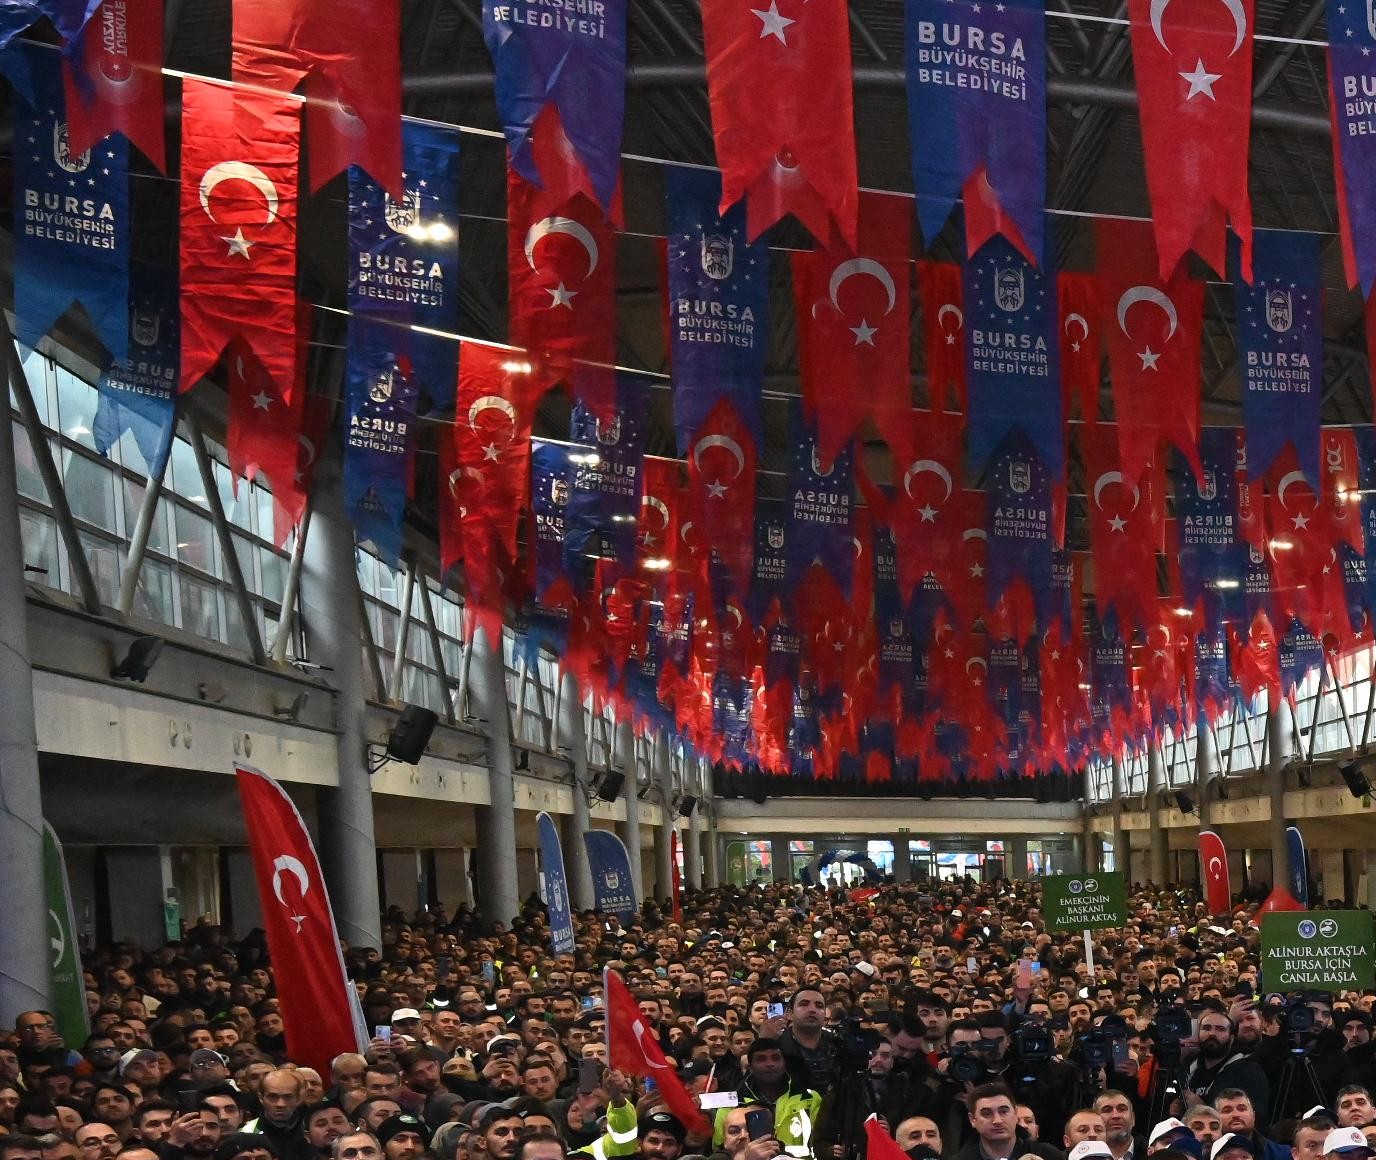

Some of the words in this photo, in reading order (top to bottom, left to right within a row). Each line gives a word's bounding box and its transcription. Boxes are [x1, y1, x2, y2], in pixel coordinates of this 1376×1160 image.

[918, 21, 1026, 61] BURSA
[919, 69, 1027, 101] BELEDİYESİ
[25, 189, 114, 220] BURSA
[360, 252, 443, 279] BURSA
[678, 298, 754, 322] BURSA
[972, 329, 1048, 351] BURSA
[1247, 351, 1310, 368] BURSA
[600, 895, 631, 904] BURSA
[1060, 895, 1110, 906] EMEKÇİNİN
[1067, 905, 1104, 915] BAŞKANI
[1056, 914, 1089, 925] ALİNUR
[1089, 913, 1117, 924] AKTAŞ
[1268, 946, 1315, 958] ALİNUR
[1285, 959, 1321, 971] BURSA
[1325, 957, 1351, 972] İÇİN
[1280, 972, 1320, 984] CANLA
[1323, 971, 1357, 985] BAŞLA
